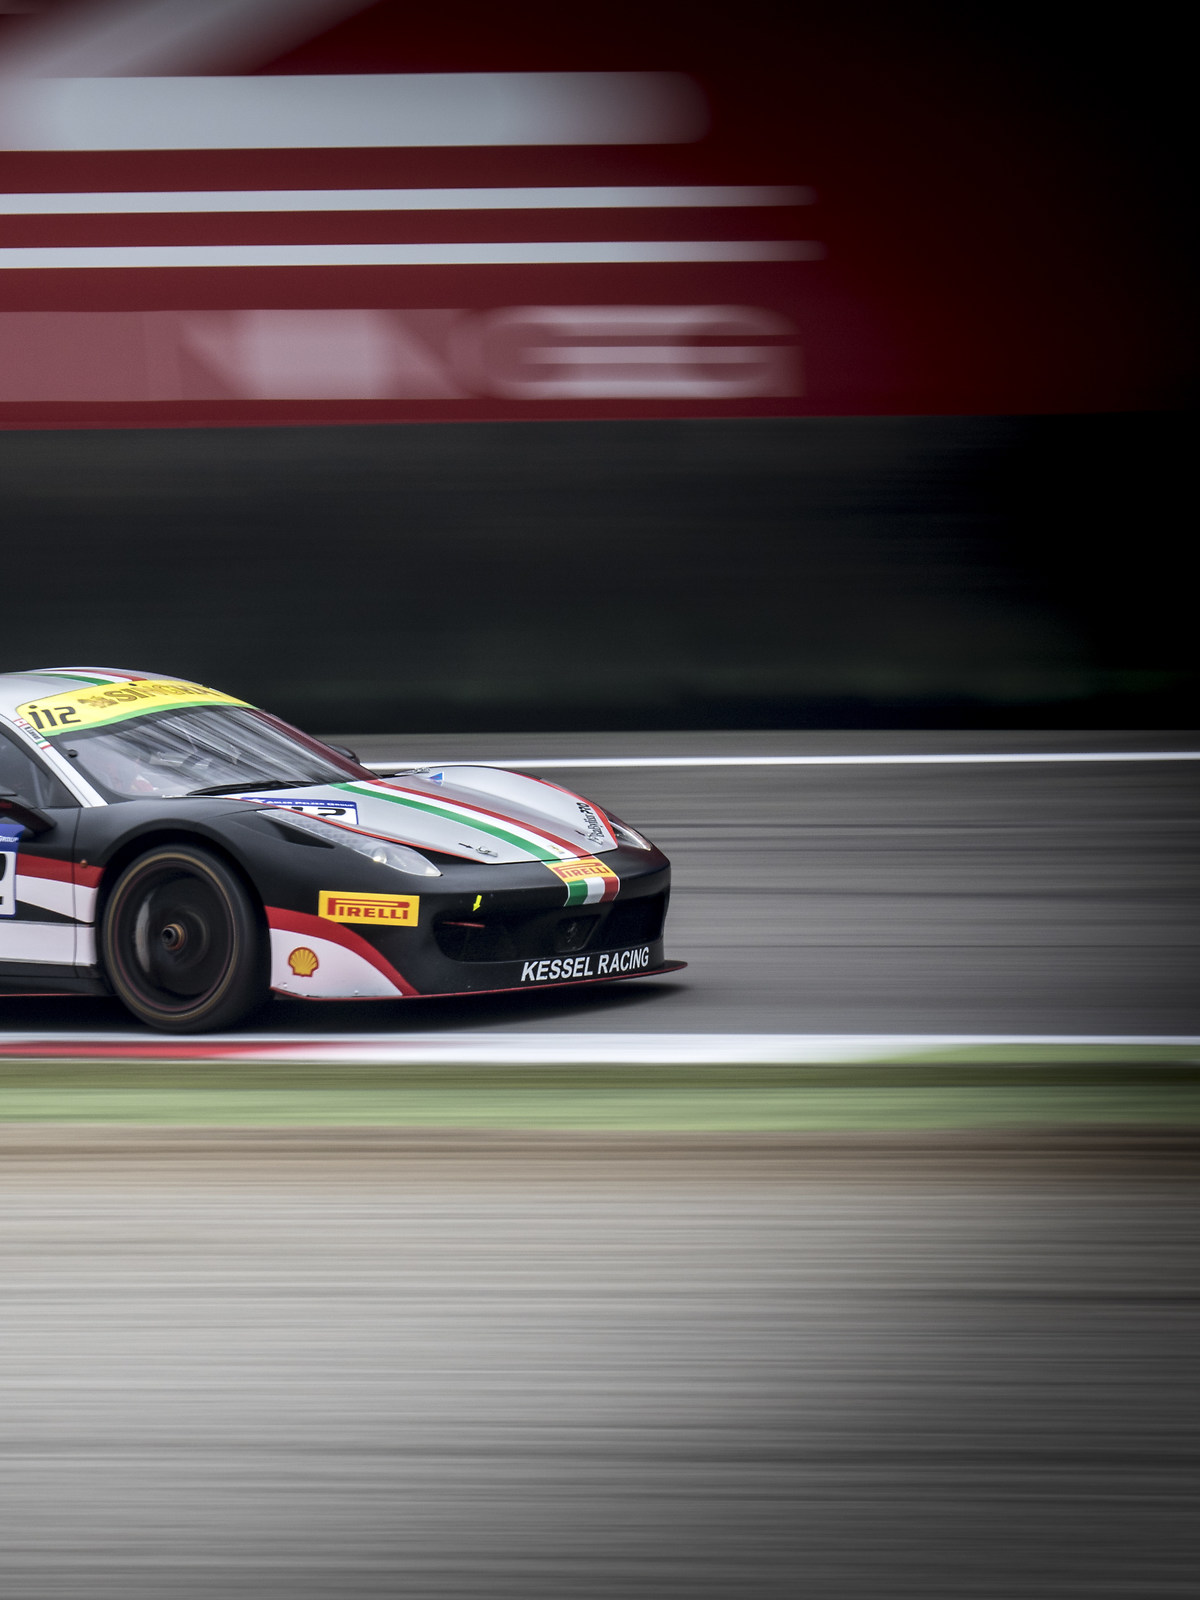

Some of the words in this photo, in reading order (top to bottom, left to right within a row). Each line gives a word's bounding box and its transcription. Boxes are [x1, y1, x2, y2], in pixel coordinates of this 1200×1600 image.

[553, 862, 611, 879] PIRELLI
[327, 897, 411, 920] PIRELLI
[520, 957, 594, 982] KESSEL
[597, 947, 649, 975] RACING
